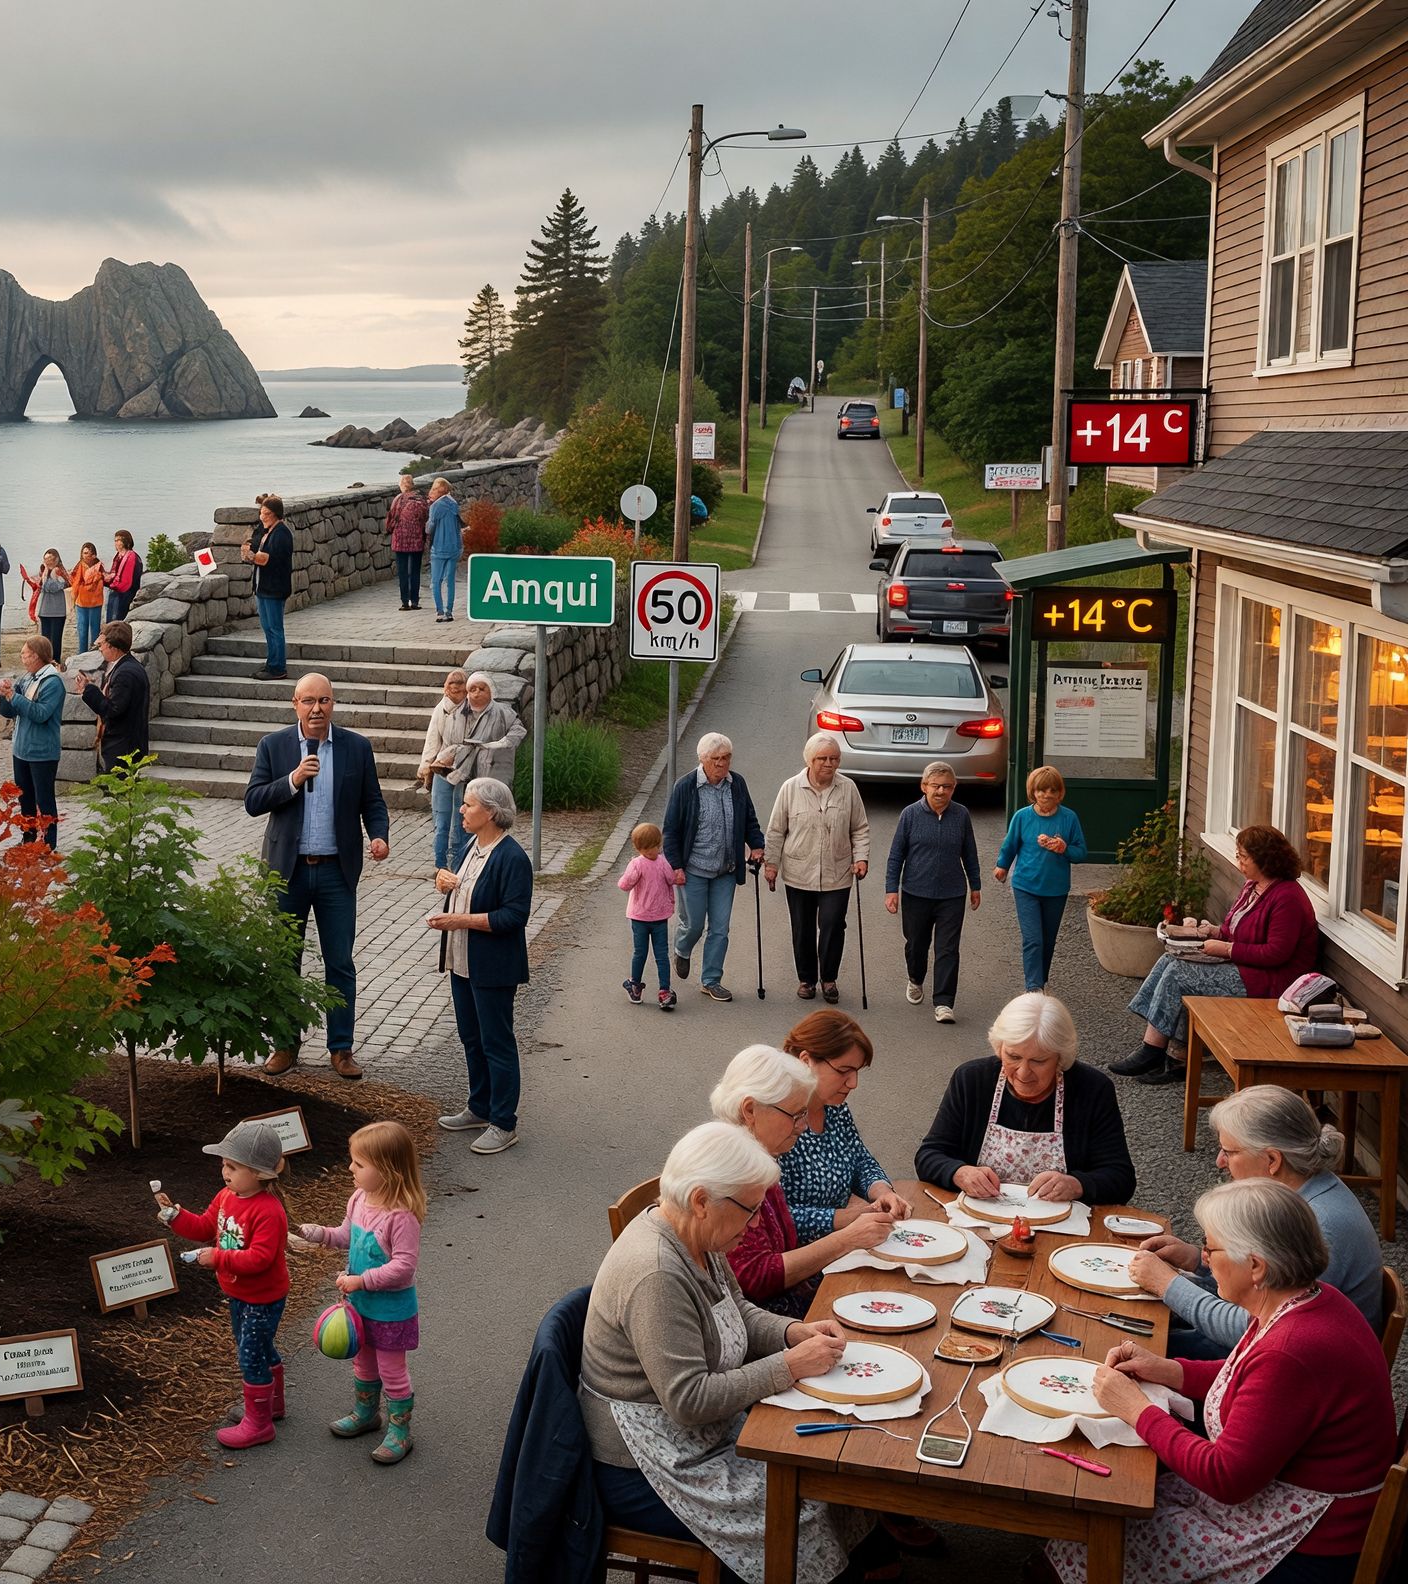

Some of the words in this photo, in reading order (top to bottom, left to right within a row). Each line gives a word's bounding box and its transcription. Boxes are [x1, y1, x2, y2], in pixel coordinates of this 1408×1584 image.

[1076, 412, 1151, 453] +14
[1163, 409, 1183, 434] C
[481, 570, 598, 614] Amqui
[650, 589, 702, 625] 50
[650, 631, 699, 651] km/h
